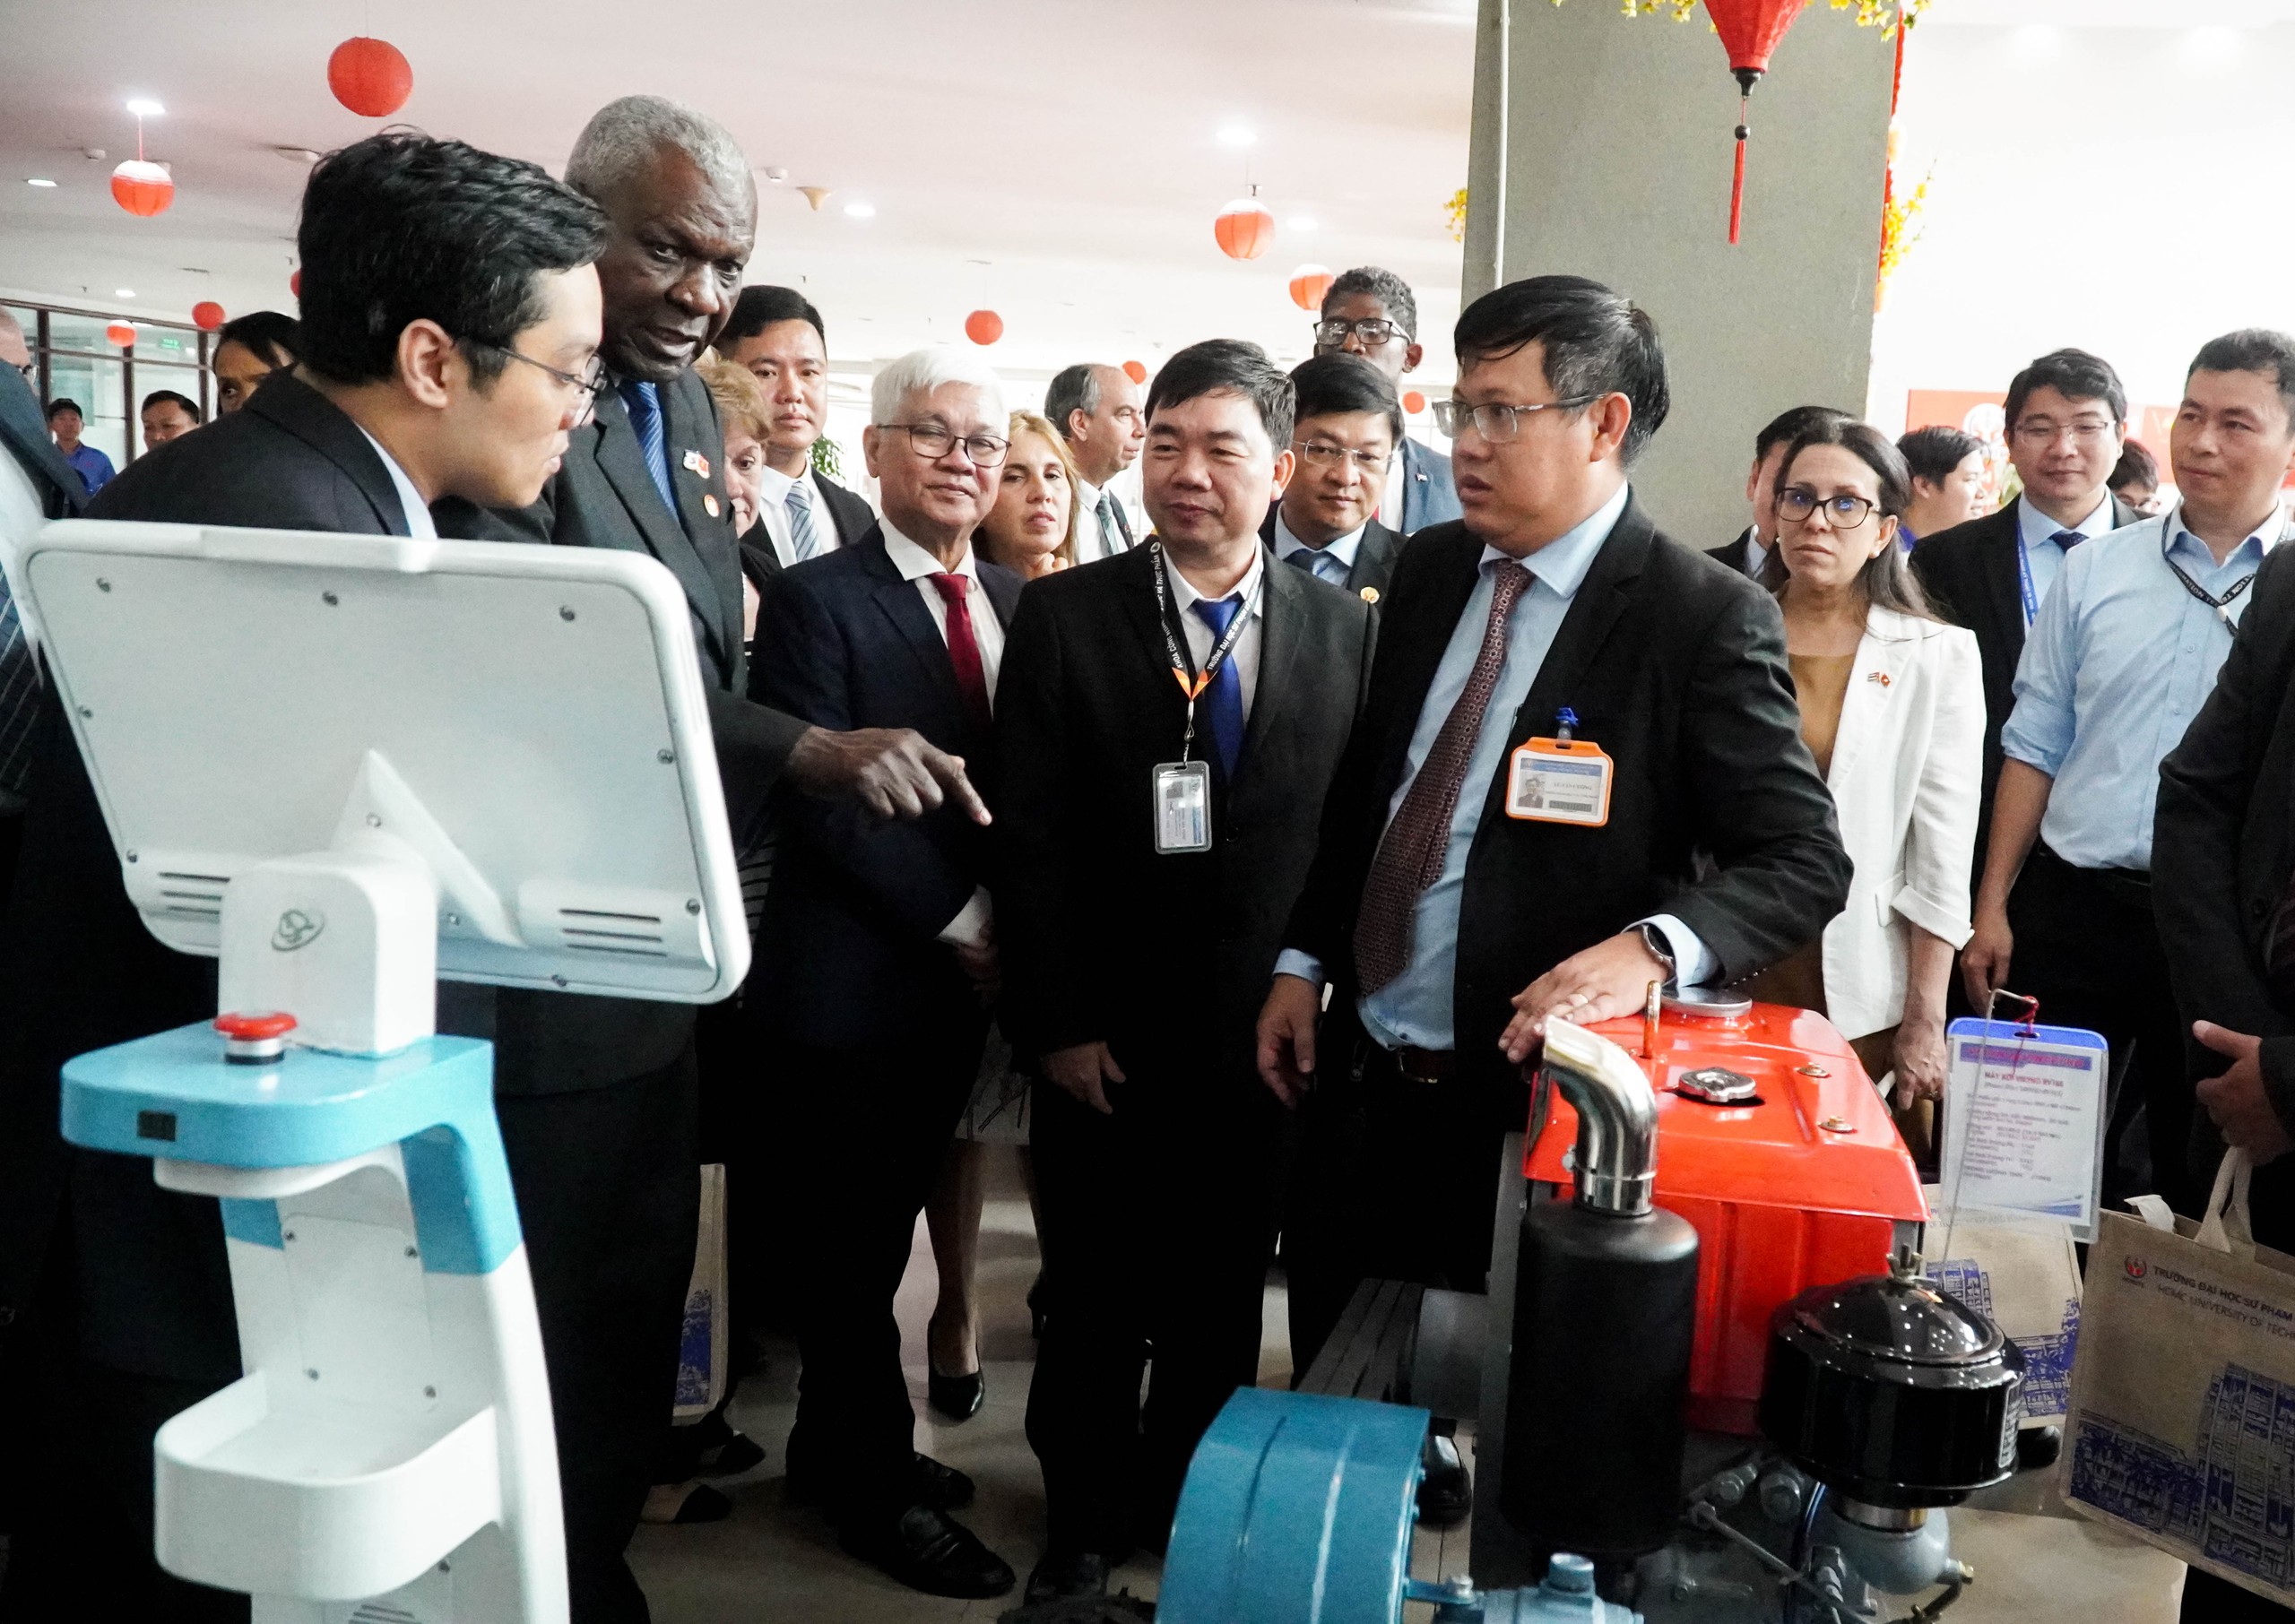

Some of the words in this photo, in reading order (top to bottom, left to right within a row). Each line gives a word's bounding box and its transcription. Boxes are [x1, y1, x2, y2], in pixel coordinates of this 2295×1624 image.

[1155, 585, 1164, 594] VÀ
[1167, 635, 1176, 652] CÔNG
[1207, 648, 1224, 670] TRƯỜNG
[1226, 630, 1235, 642] HỌC
[1231, 622, 1240, 632] SƯ
[1236, 610, 1247, 626] PHẠM
[1172, 652, 1183, 668] KHOA
[2190, 1296, 2247, 1323] UNIVERSITY
[2250, 1317, 2263, 1327] OF
